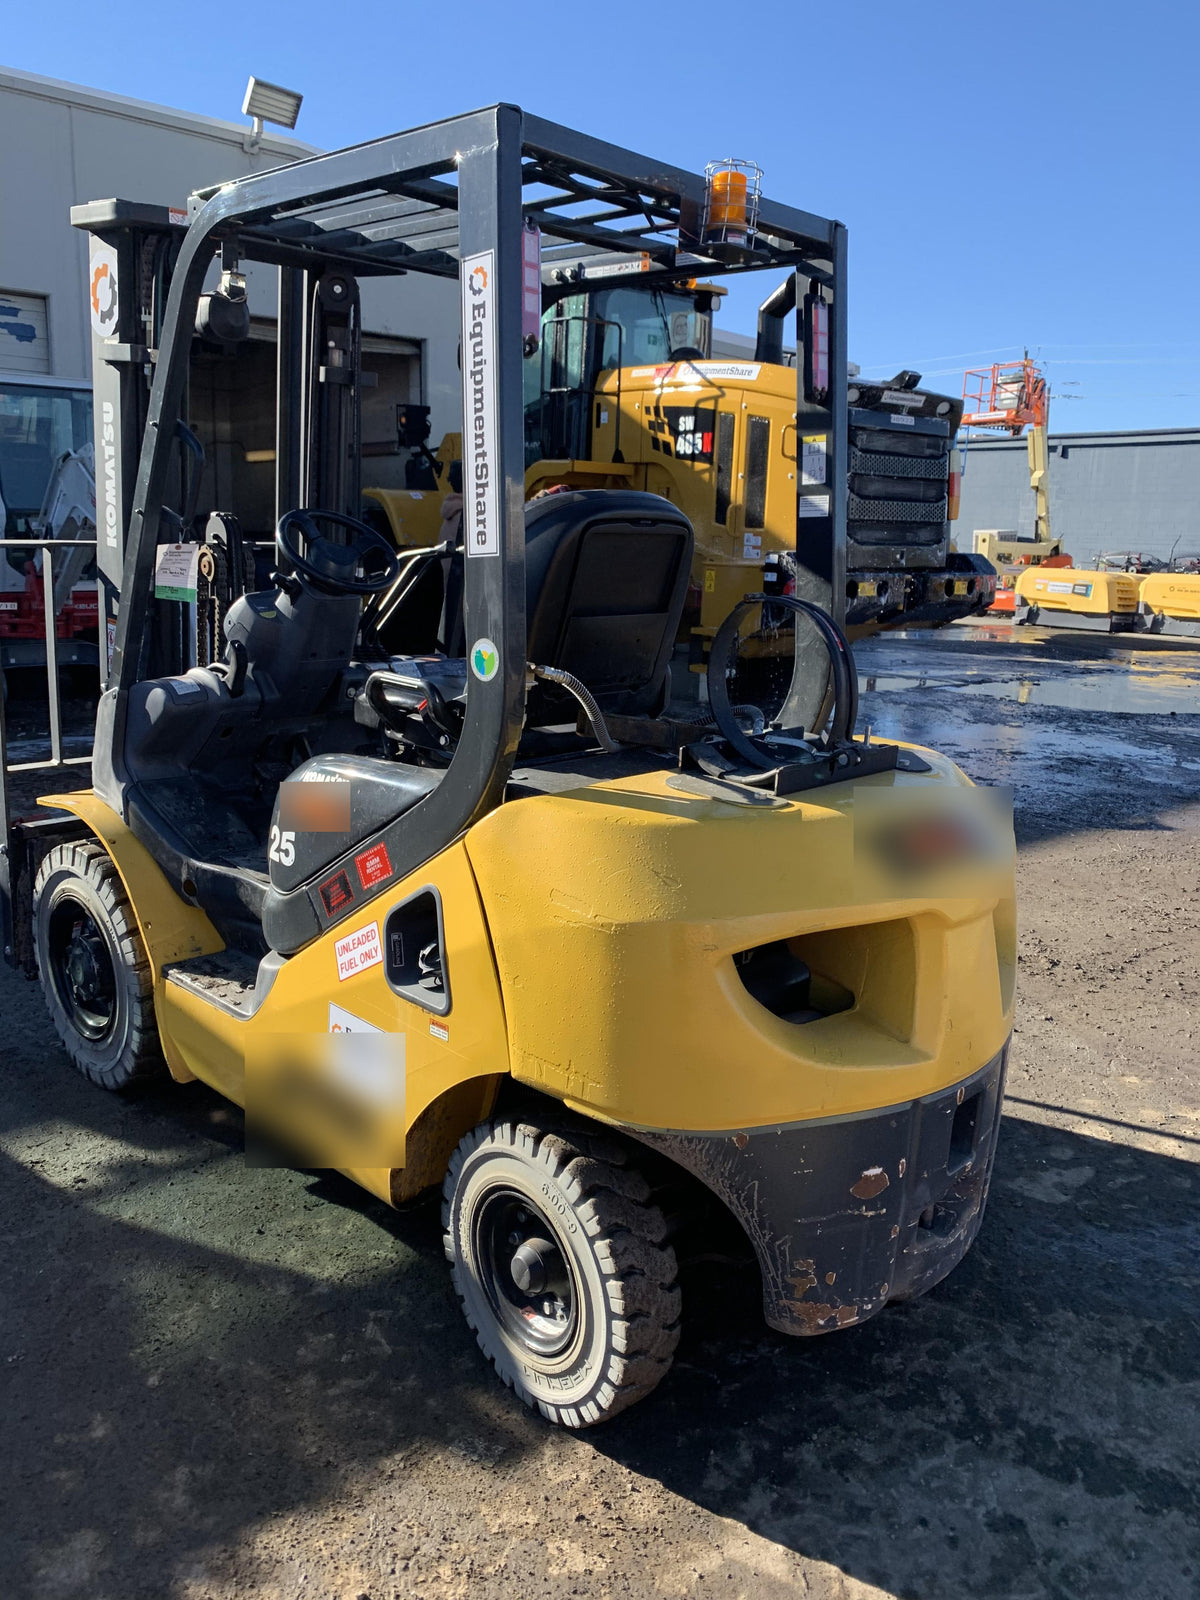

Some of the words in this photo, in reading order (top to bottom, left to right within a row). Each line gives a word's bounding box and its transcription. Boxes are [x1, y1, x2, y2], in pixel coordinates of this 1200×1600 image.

[469, 300, 488, 547] EquipmentShare
[678, 415, 695, 431] SW
[101, 401, 117, 548] KOMATSU
[269, 825, 295, 866] 25
[337, 928, 376, 957] UNLEADED
[340, 958, 359, 974] FUEL
[359, 945, 379, 965] ONLY
